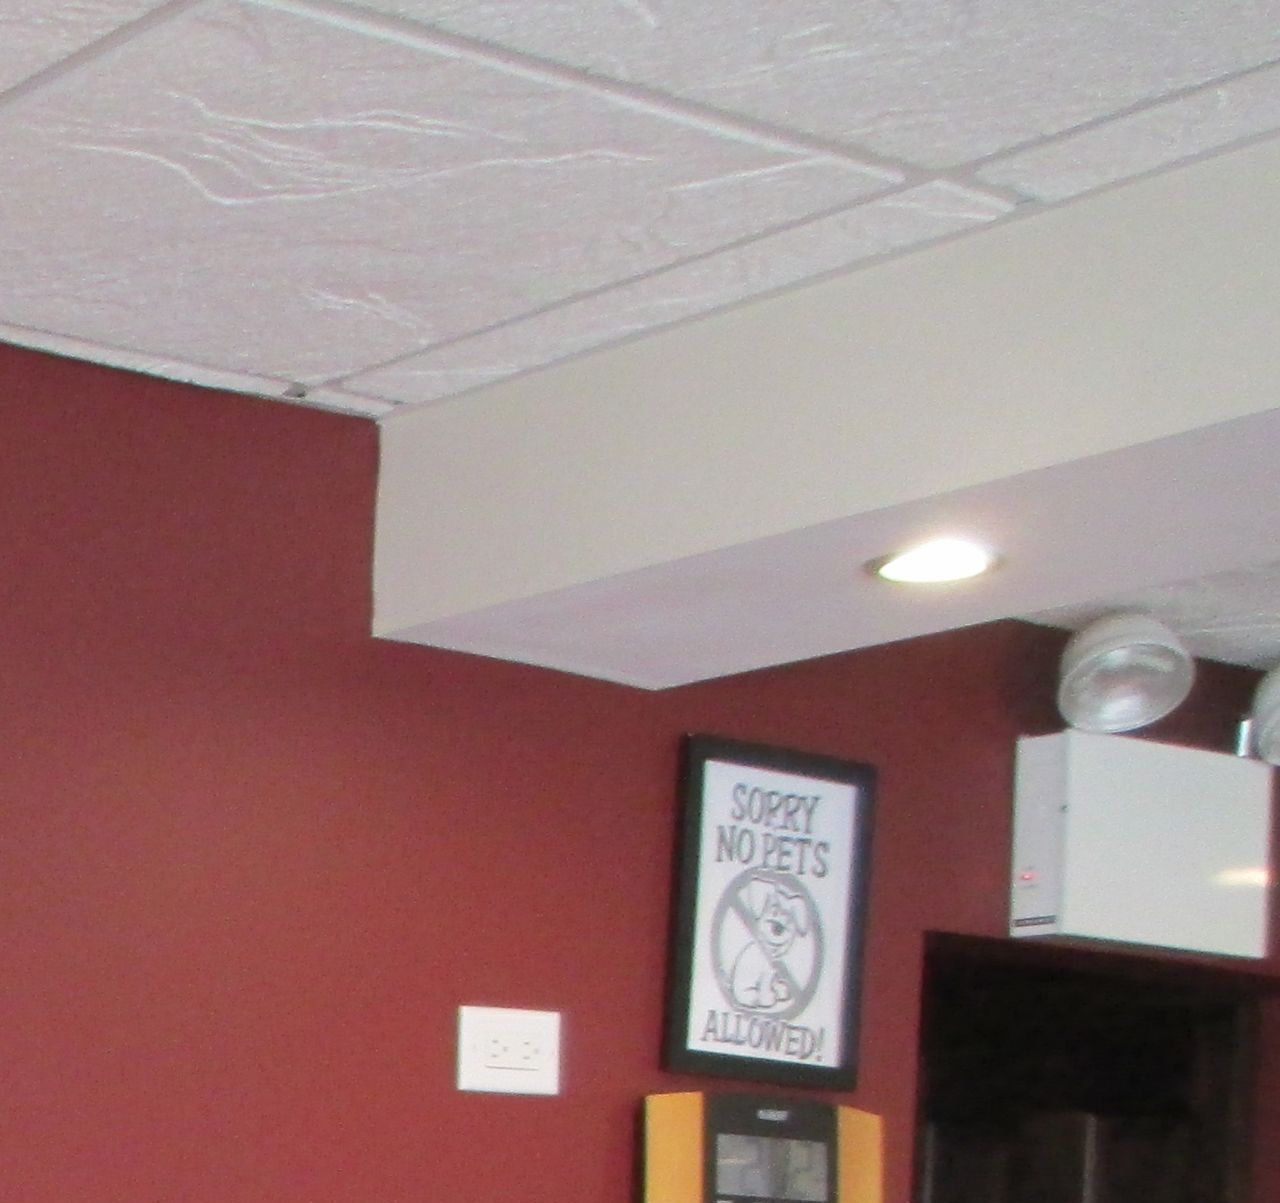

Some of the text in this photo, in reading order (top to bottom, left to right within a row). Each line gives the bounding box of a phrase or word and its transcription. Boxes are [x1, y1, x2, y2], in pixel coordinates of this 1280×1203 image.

[731, 782, 821, 834] SORRY
[715, 824, 830, 878] NO PETS
[700, 1009, 826, 1062] ALLOWED!
